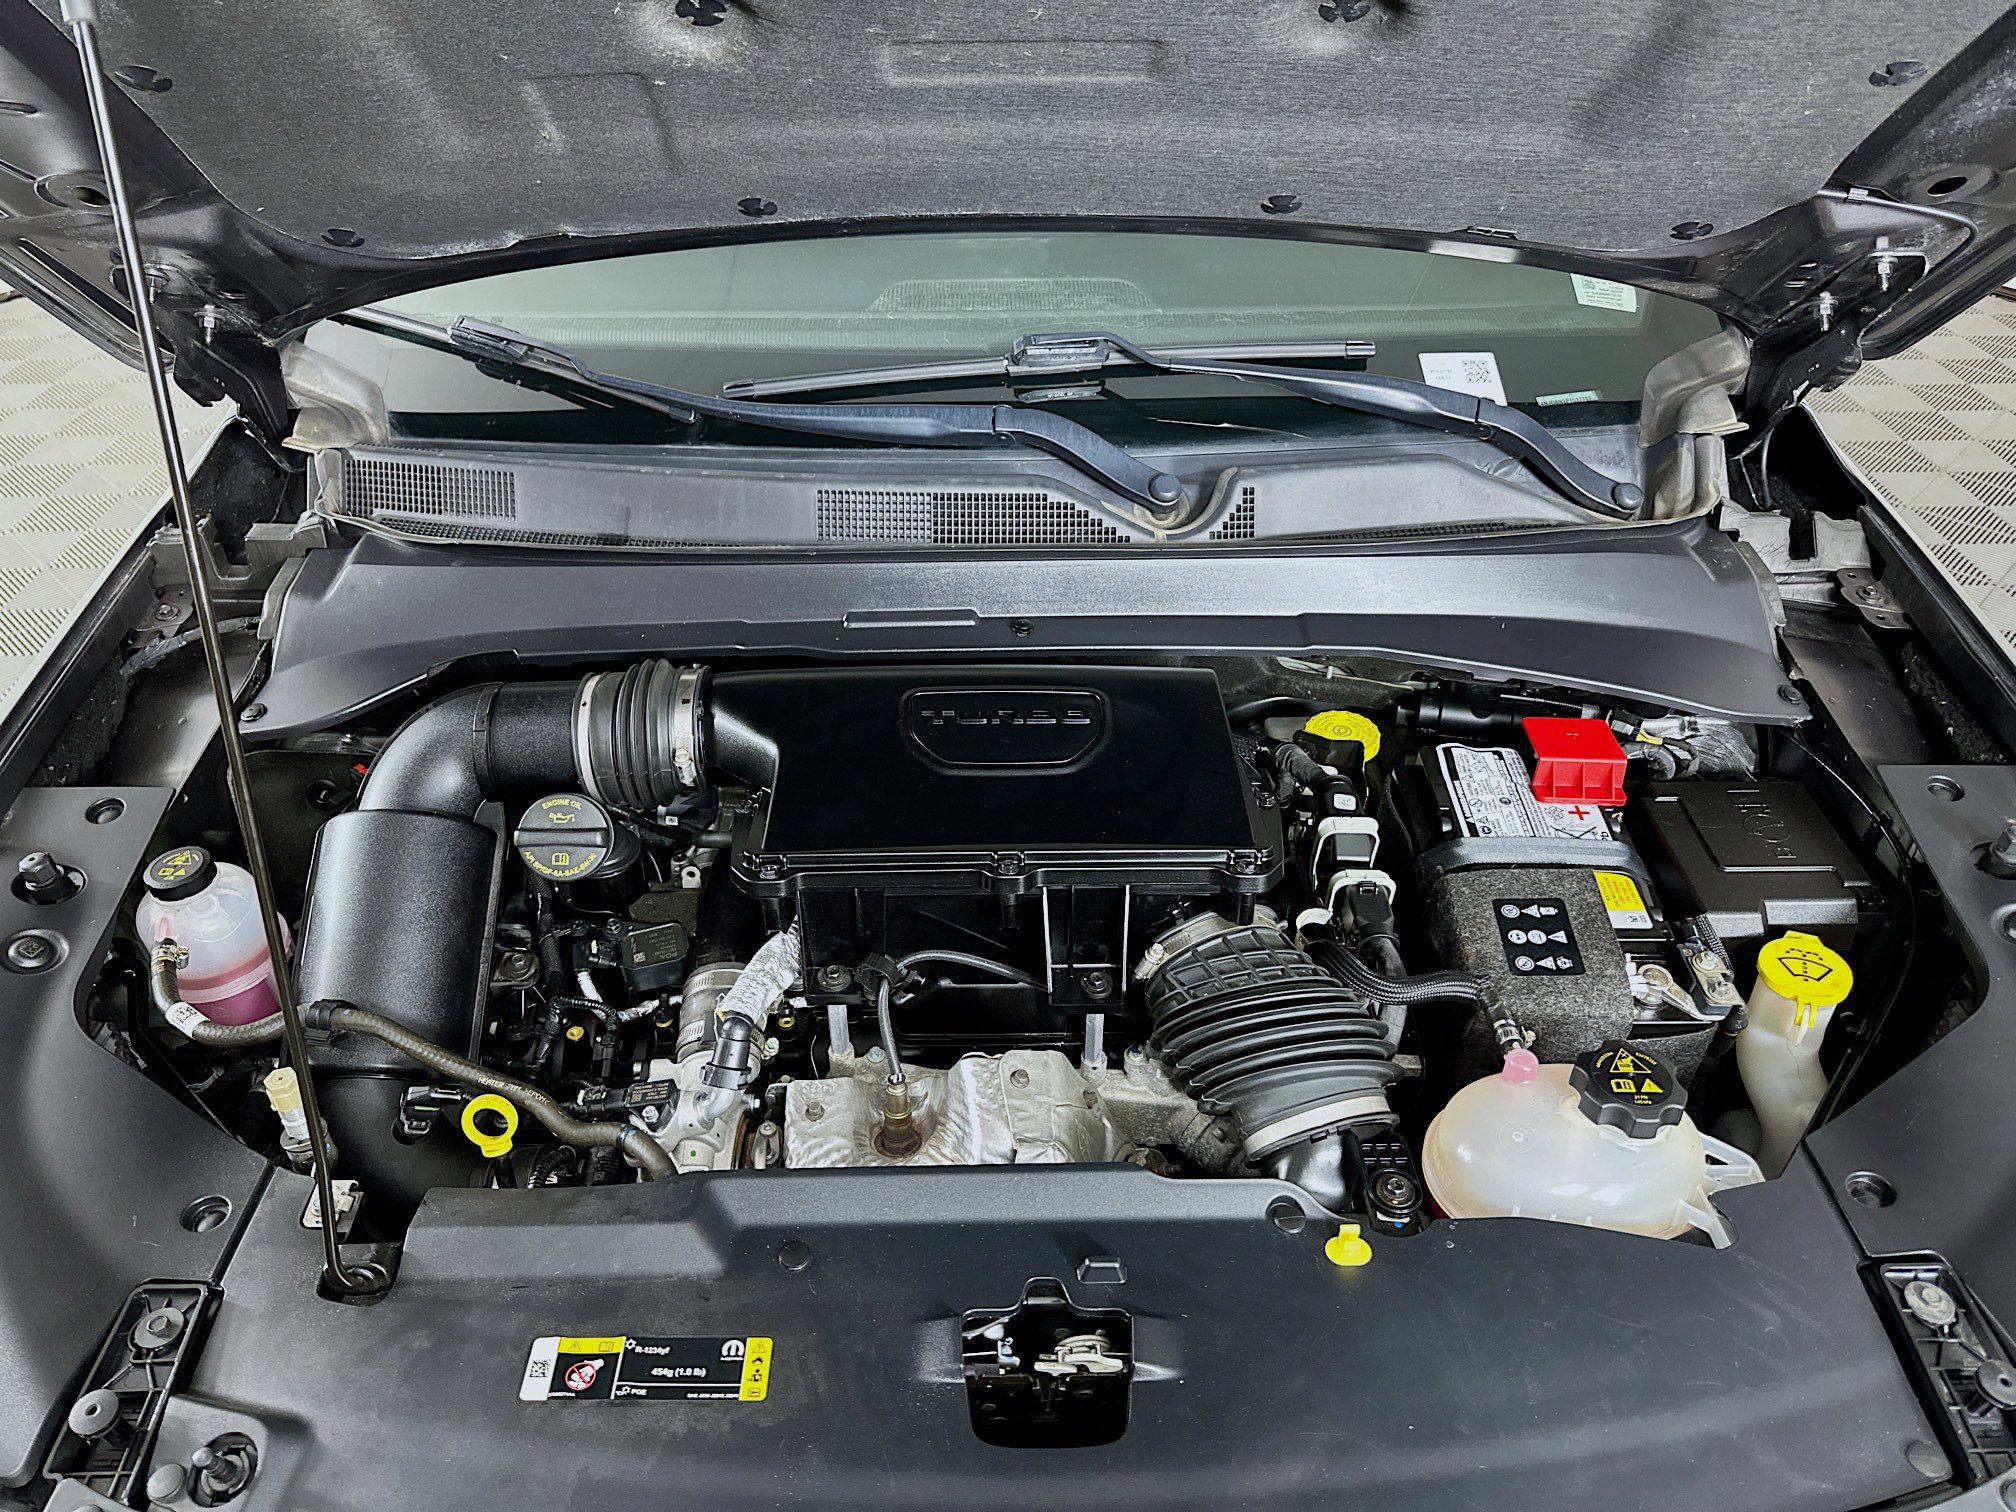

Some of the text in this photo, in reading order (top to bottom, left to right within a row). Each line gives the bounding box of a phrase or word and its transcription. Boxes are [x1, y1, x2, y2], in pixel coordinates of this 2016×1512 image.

[921, 710, 1091, 725] TURBO
[542, 798, 582, 810] ENGINE OIL
[523, 851, 533, 862] API
[478, 1076, 505, 1089] HEATER
[635, 1346, 670, 1355] R-1234yf
[651, 1367, 674, 1378] 454g
